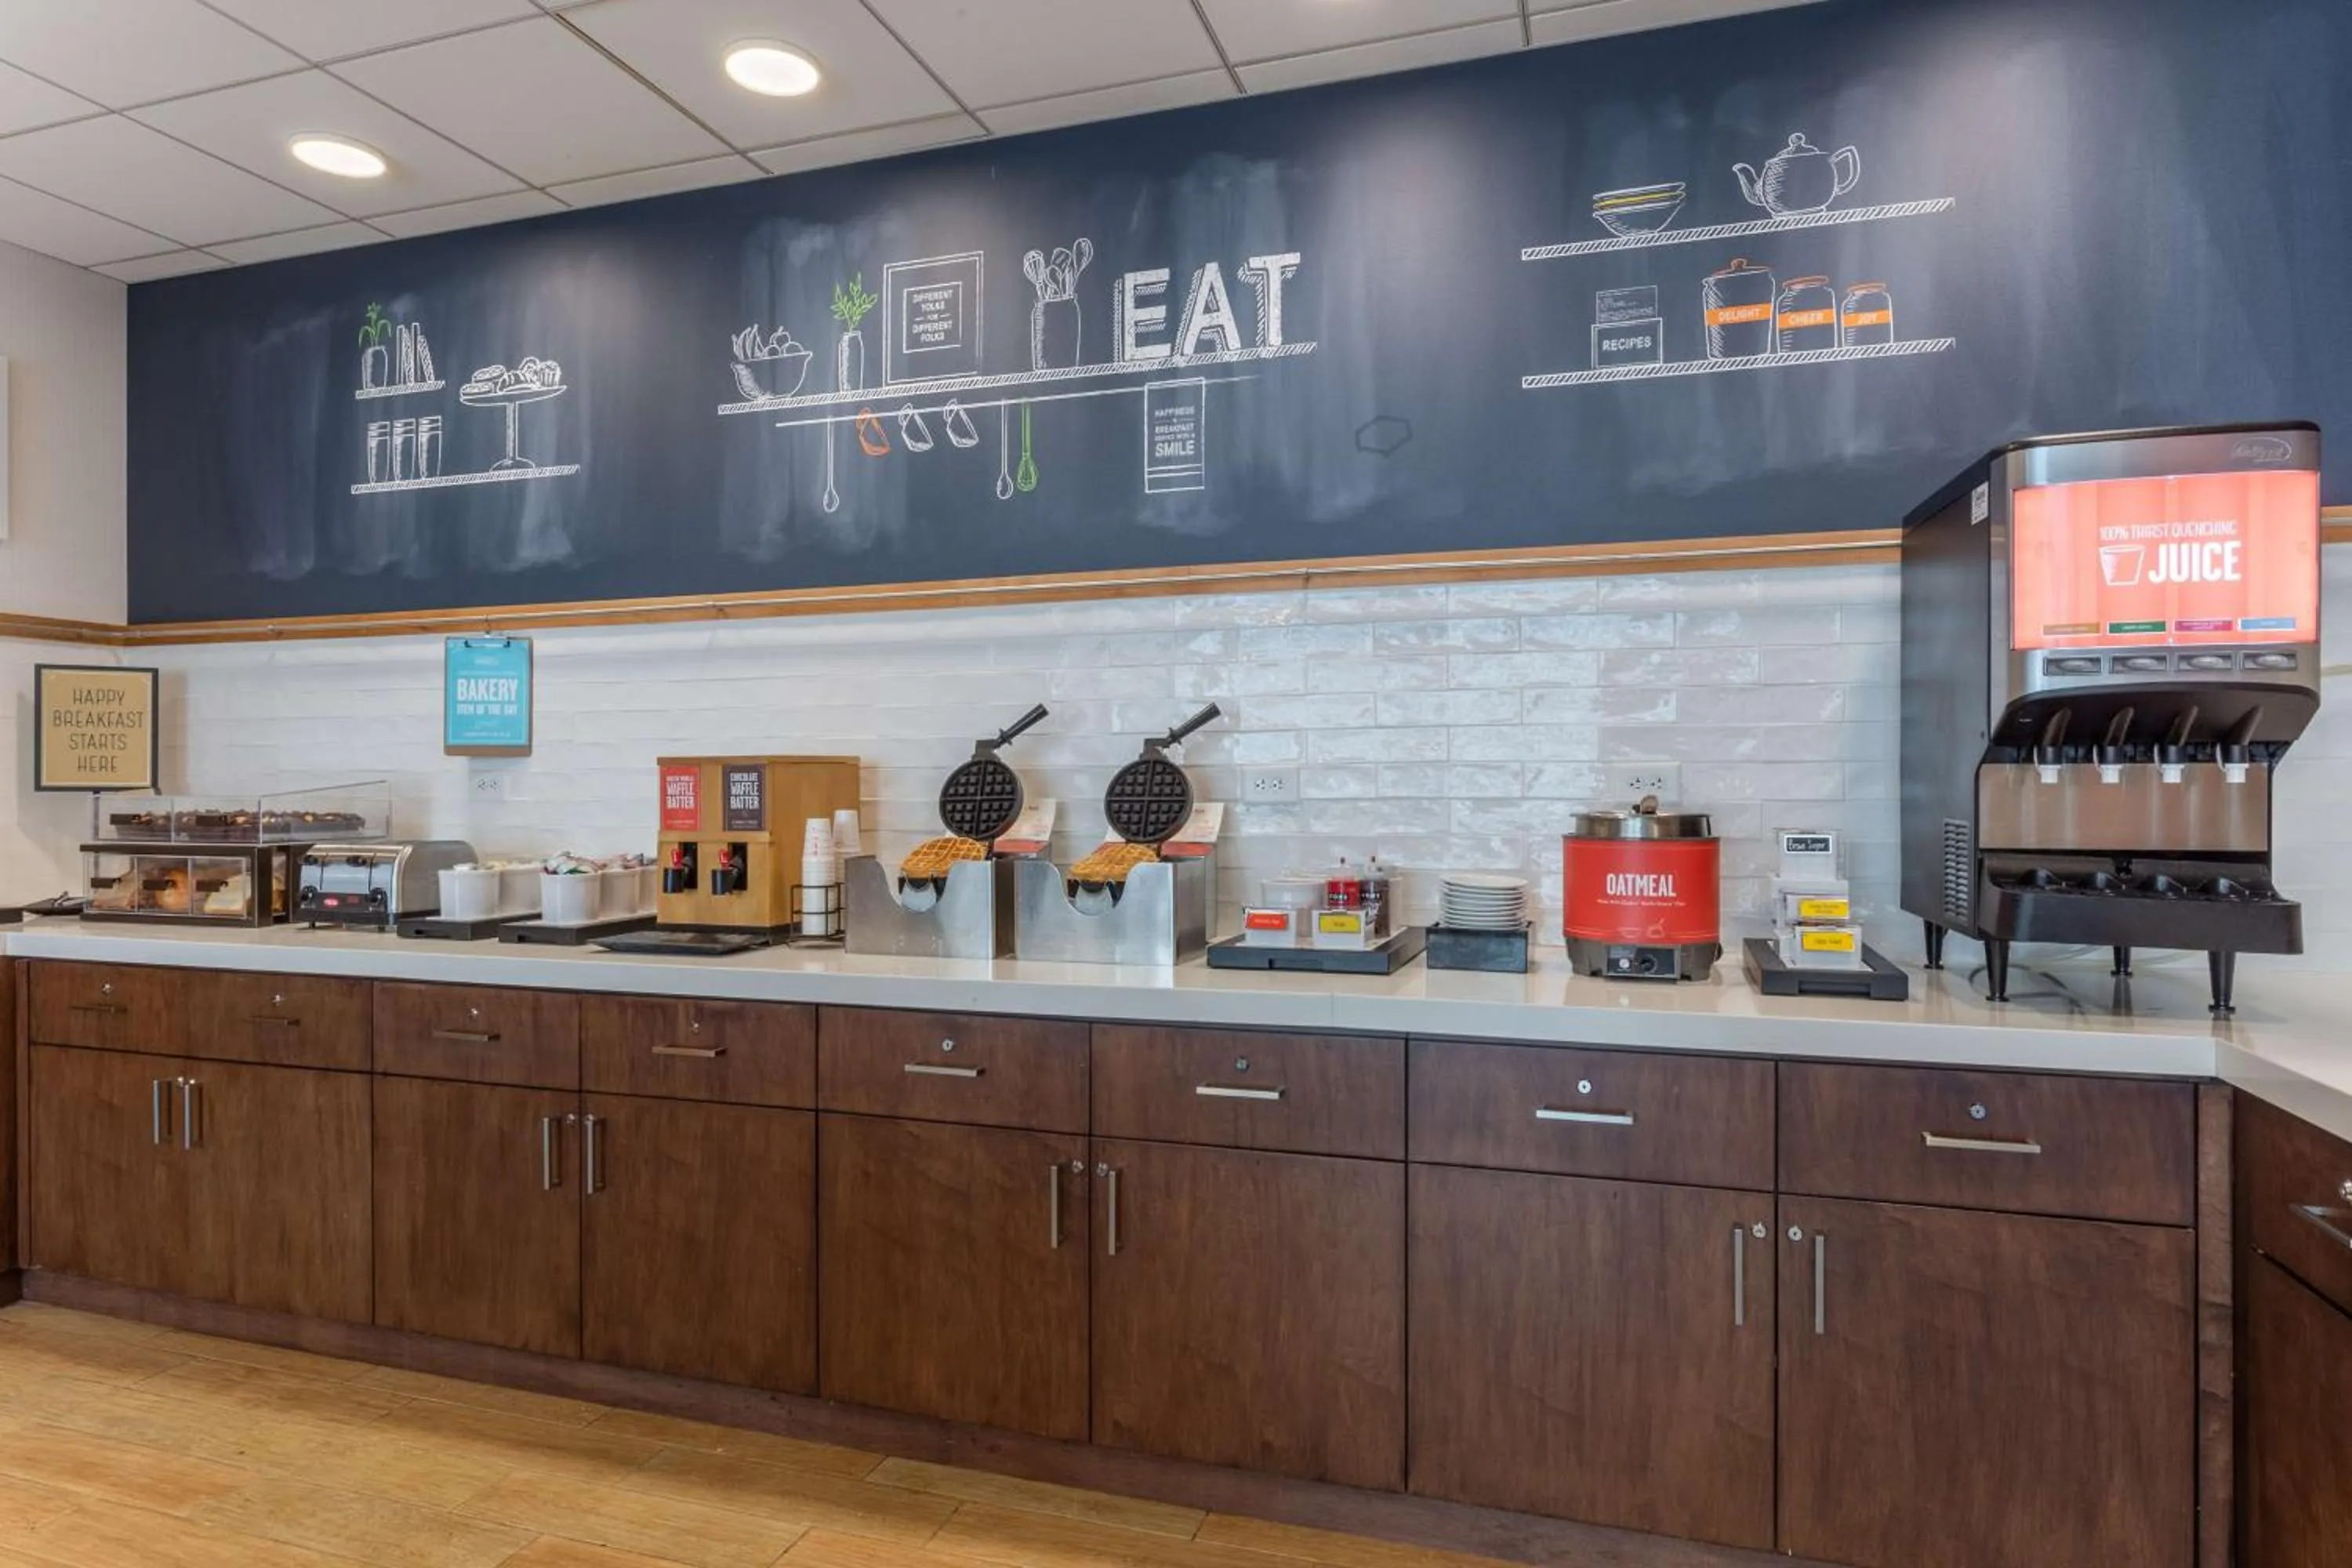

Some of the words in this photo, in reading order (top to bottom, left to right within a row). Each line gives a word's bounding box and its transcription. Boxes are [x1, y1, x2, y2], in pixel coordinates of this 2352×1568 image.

[913, 289, 953, 303] DIFFERENT
[1113, 252, 1301, 362] EAT
[1719, 307, 1762, 321] DELIGHT
[913, 320, 953, 334] DIFFERENT
[1788, 313, 1824, 325] CHEER
[1602, 336, 1652, 351] RECIPES
[1155, 440, 1195, 457] SMILE
[2100, 526, 2129, 541] 100%
[2132, 523, 2170, 539] THIRST
[2171, 520, 2237, 538] QUENCHING
[2147, 540, 2242, 584] JUICE
[73, 688, 125, 706] HAPPY
[457, 678, 517, 702] BAKERY
[53, 710, 143, 728] BREAKFAST
[69, 733, 128, 750] STARTS
[77, 755, 118, 773] HERE
[667, 782, 695, 796] WAFFLE
[730, 782, 760, 795] WAFFLE
[666, 796, 695, 810] BATTER
[730, 796, 760, 810] BATTER
[1606, 873, 1677, 897] OATMEAL
